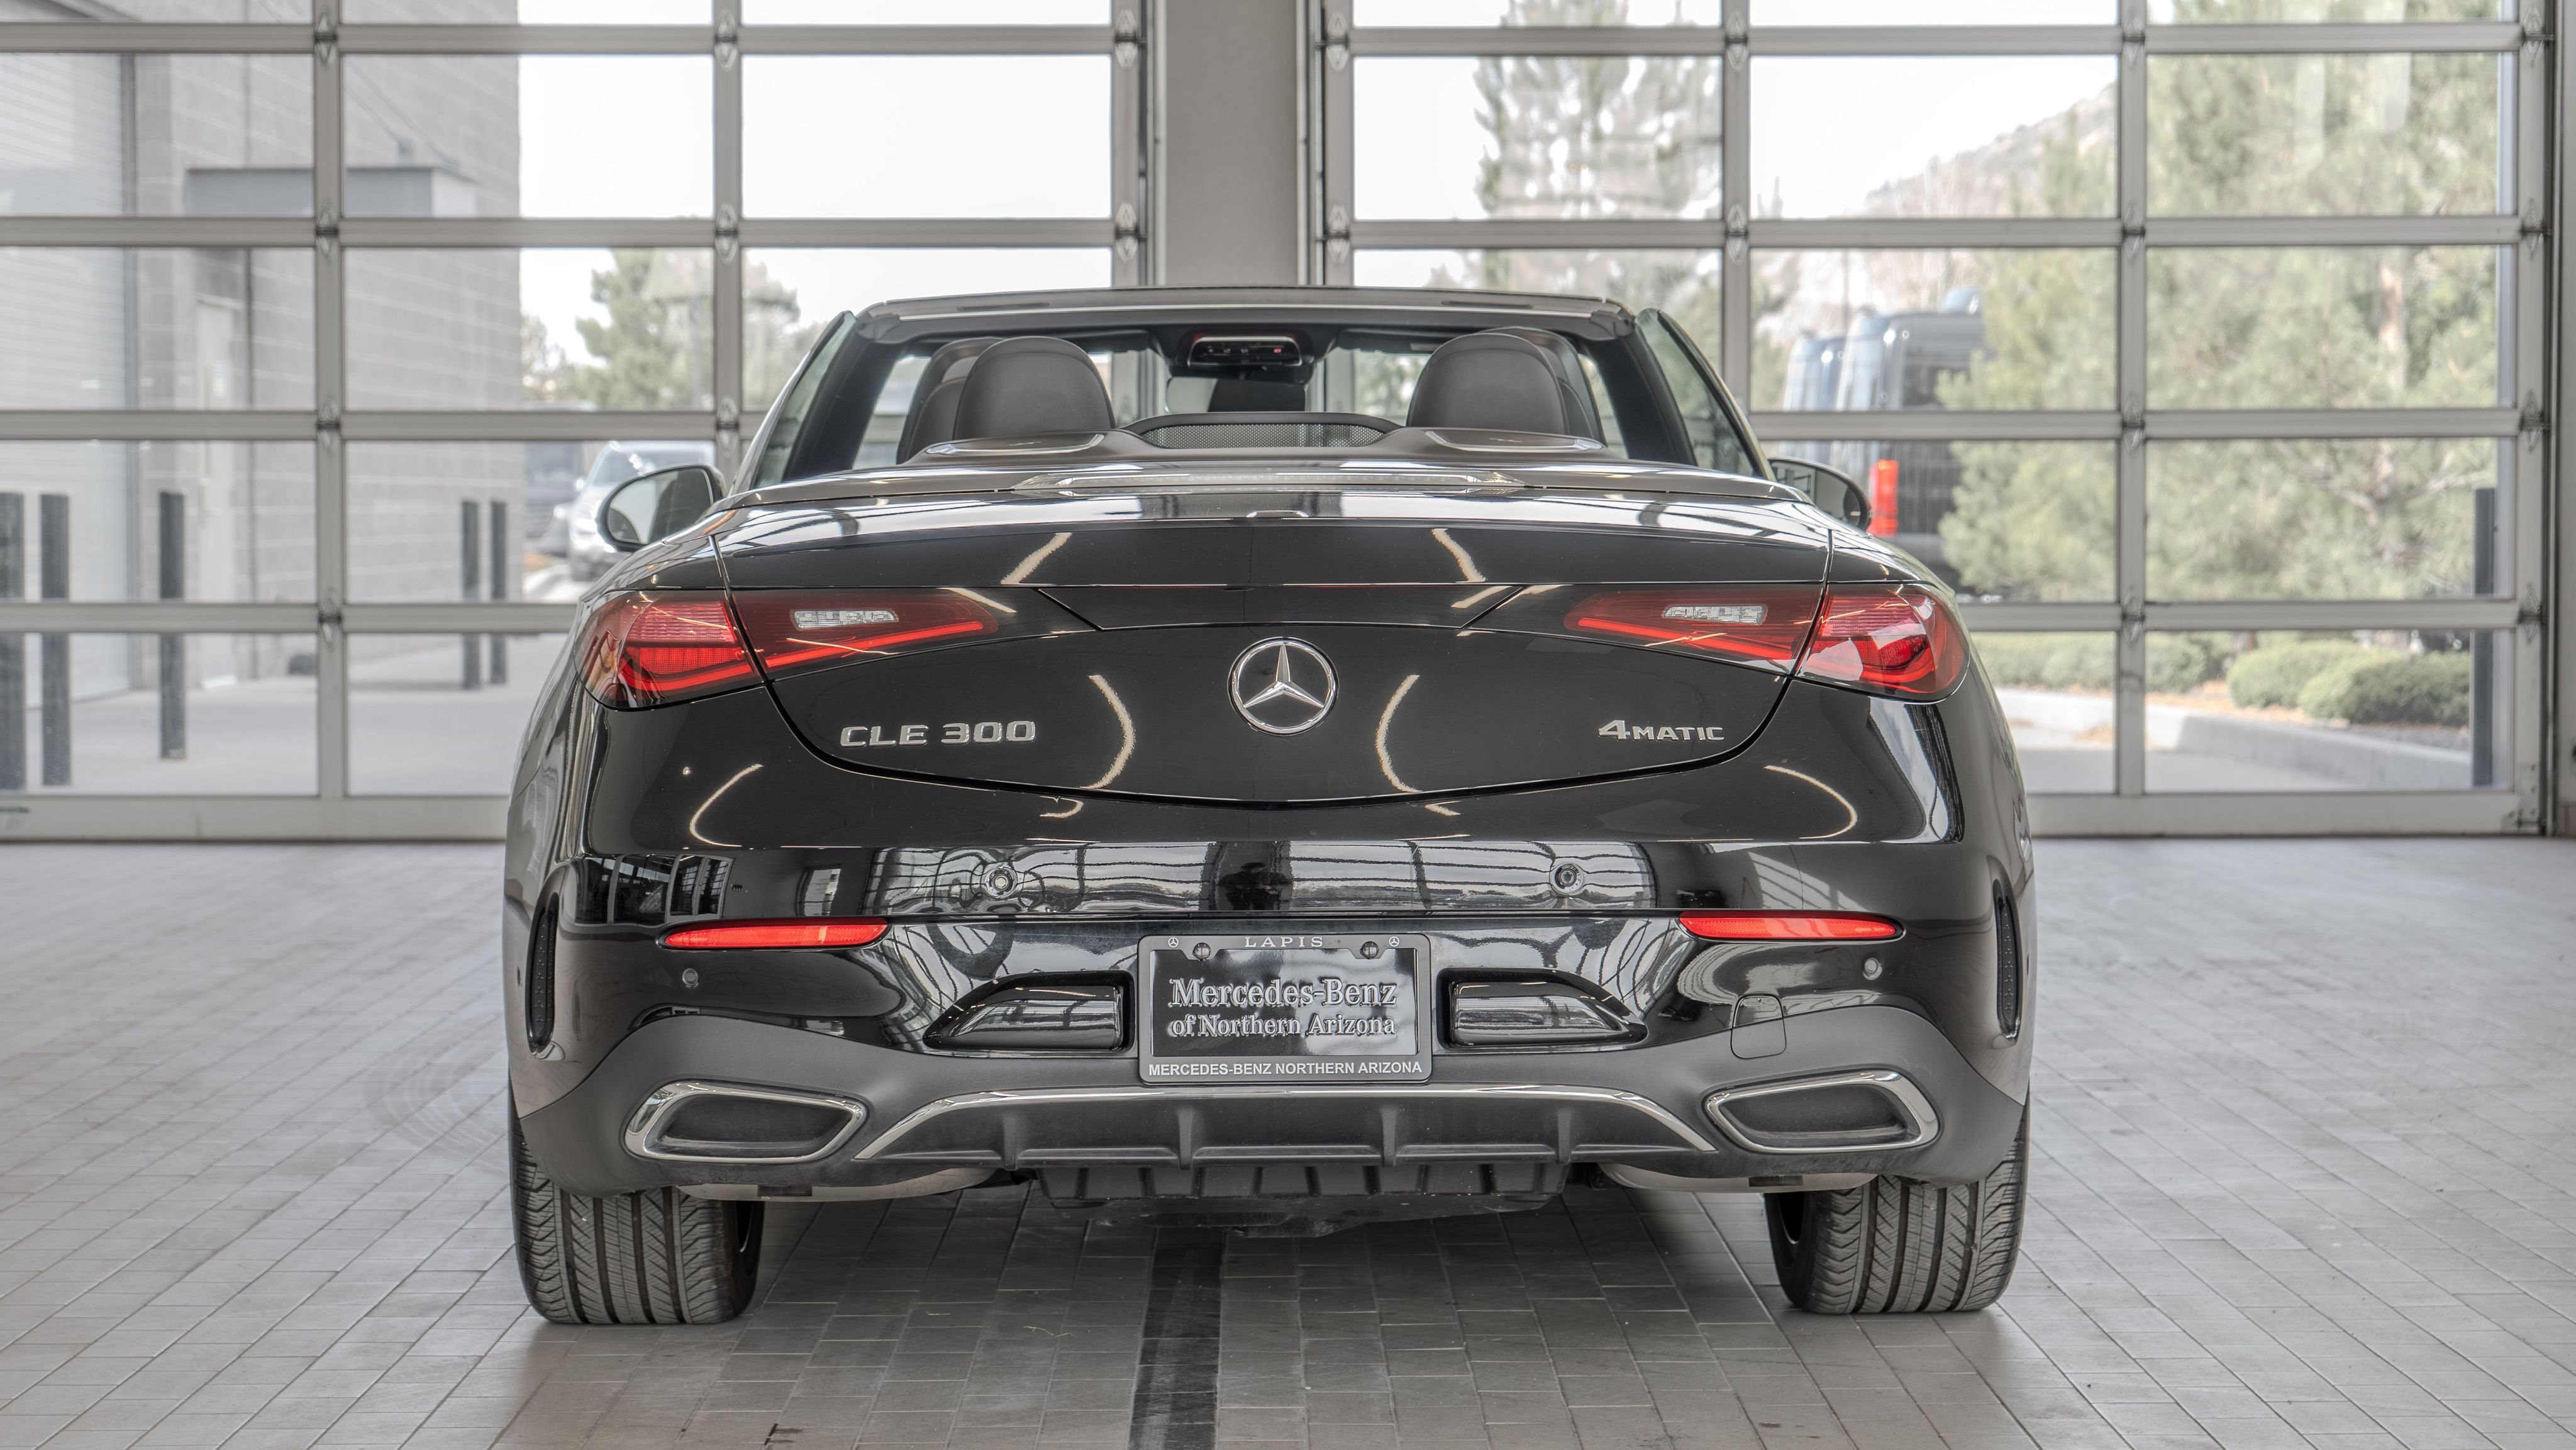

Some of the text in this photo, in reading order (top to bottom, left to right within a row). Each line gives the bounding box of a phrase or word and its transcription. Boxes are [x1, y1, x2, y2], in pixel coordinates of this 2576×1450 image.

[840, 721, 1036, 747] CLE 300
[1598, 720, 1724, 740] 4MATIC
[1245, 936, 1324, 947] LAPIS
[1169, 978, 1397, 1007] Mercedes-Benz
[1171, 1012, 1396, 1037] of Northern Arizona
[1148, 1061, 1423, 1076] MERCEDES-BENZ NORTHERN ARIZONA
